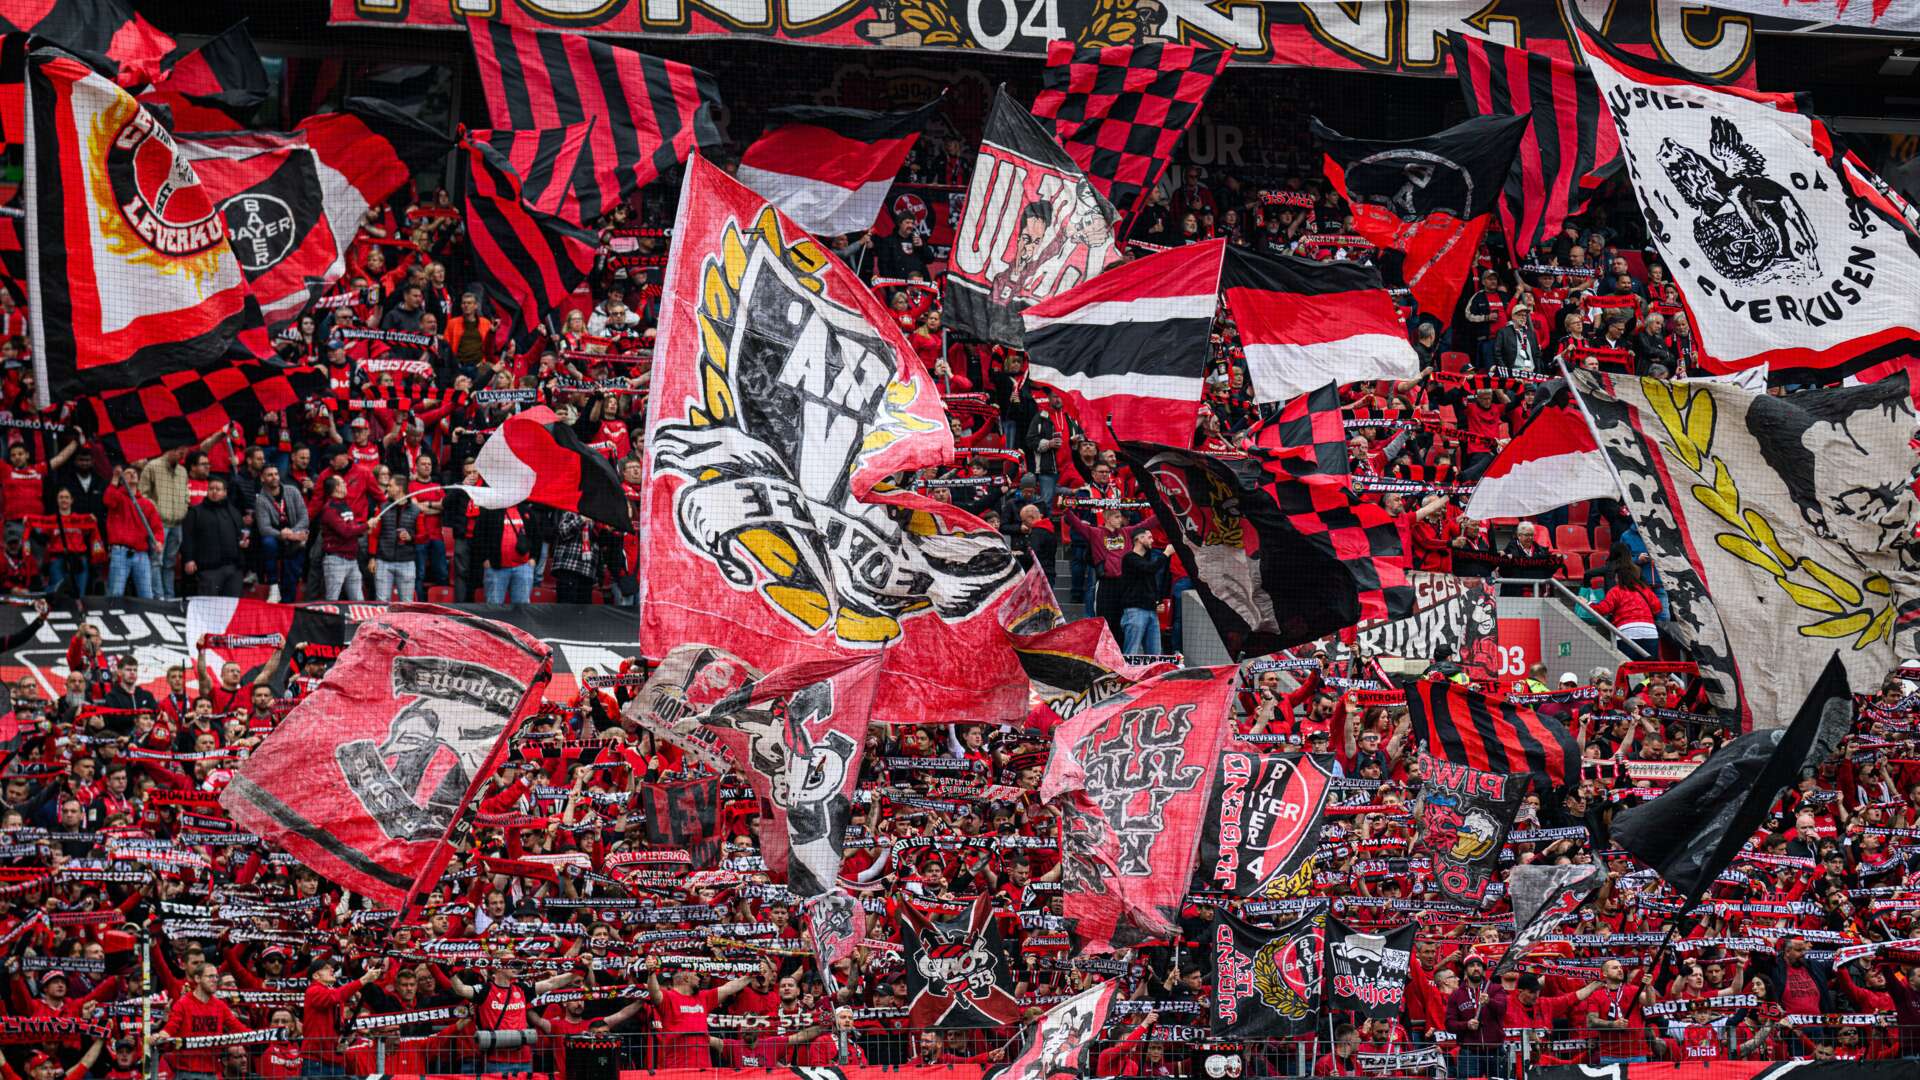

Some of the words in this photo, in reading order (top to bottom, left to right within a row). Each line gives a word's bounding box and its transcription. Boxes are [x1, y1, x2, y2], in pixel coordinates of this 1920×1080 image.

[1790, 170, 1829, 192] 04
[243, 199, 269, 265] BAYER
[1214, 752, 1251, 890] JUGEND
[911, 836, 931, 848] FÜR
[968, 837, 986, 848] DIE
[912, 898, 940, 910] Bayer
[1742, 903, 1772, 913] UNTERM
[421, 939, 482, 953] Hassia
[515, 938, 551, 952] Leo
[1299, 939, 1315, 986] BAYER
[968, 969, 995, 990] 513
[1217, 923, 1238, 1025] JUGEND
[1233, 949, 1255, 999] LEV
[1304, 986, 1322, 1001] 04
[1710, 994, 1758, 1008] HERS
[351, 1008, 450, 1030] LEVERKUSEN
[707, 1012, 772, 1028] CHAOS
[779, 1011, 814, 1027] 513
[186, 1028, 279, 1049] WESTSIDEBOYZ
[1686, 1047, 1717, 1057] Talcid
